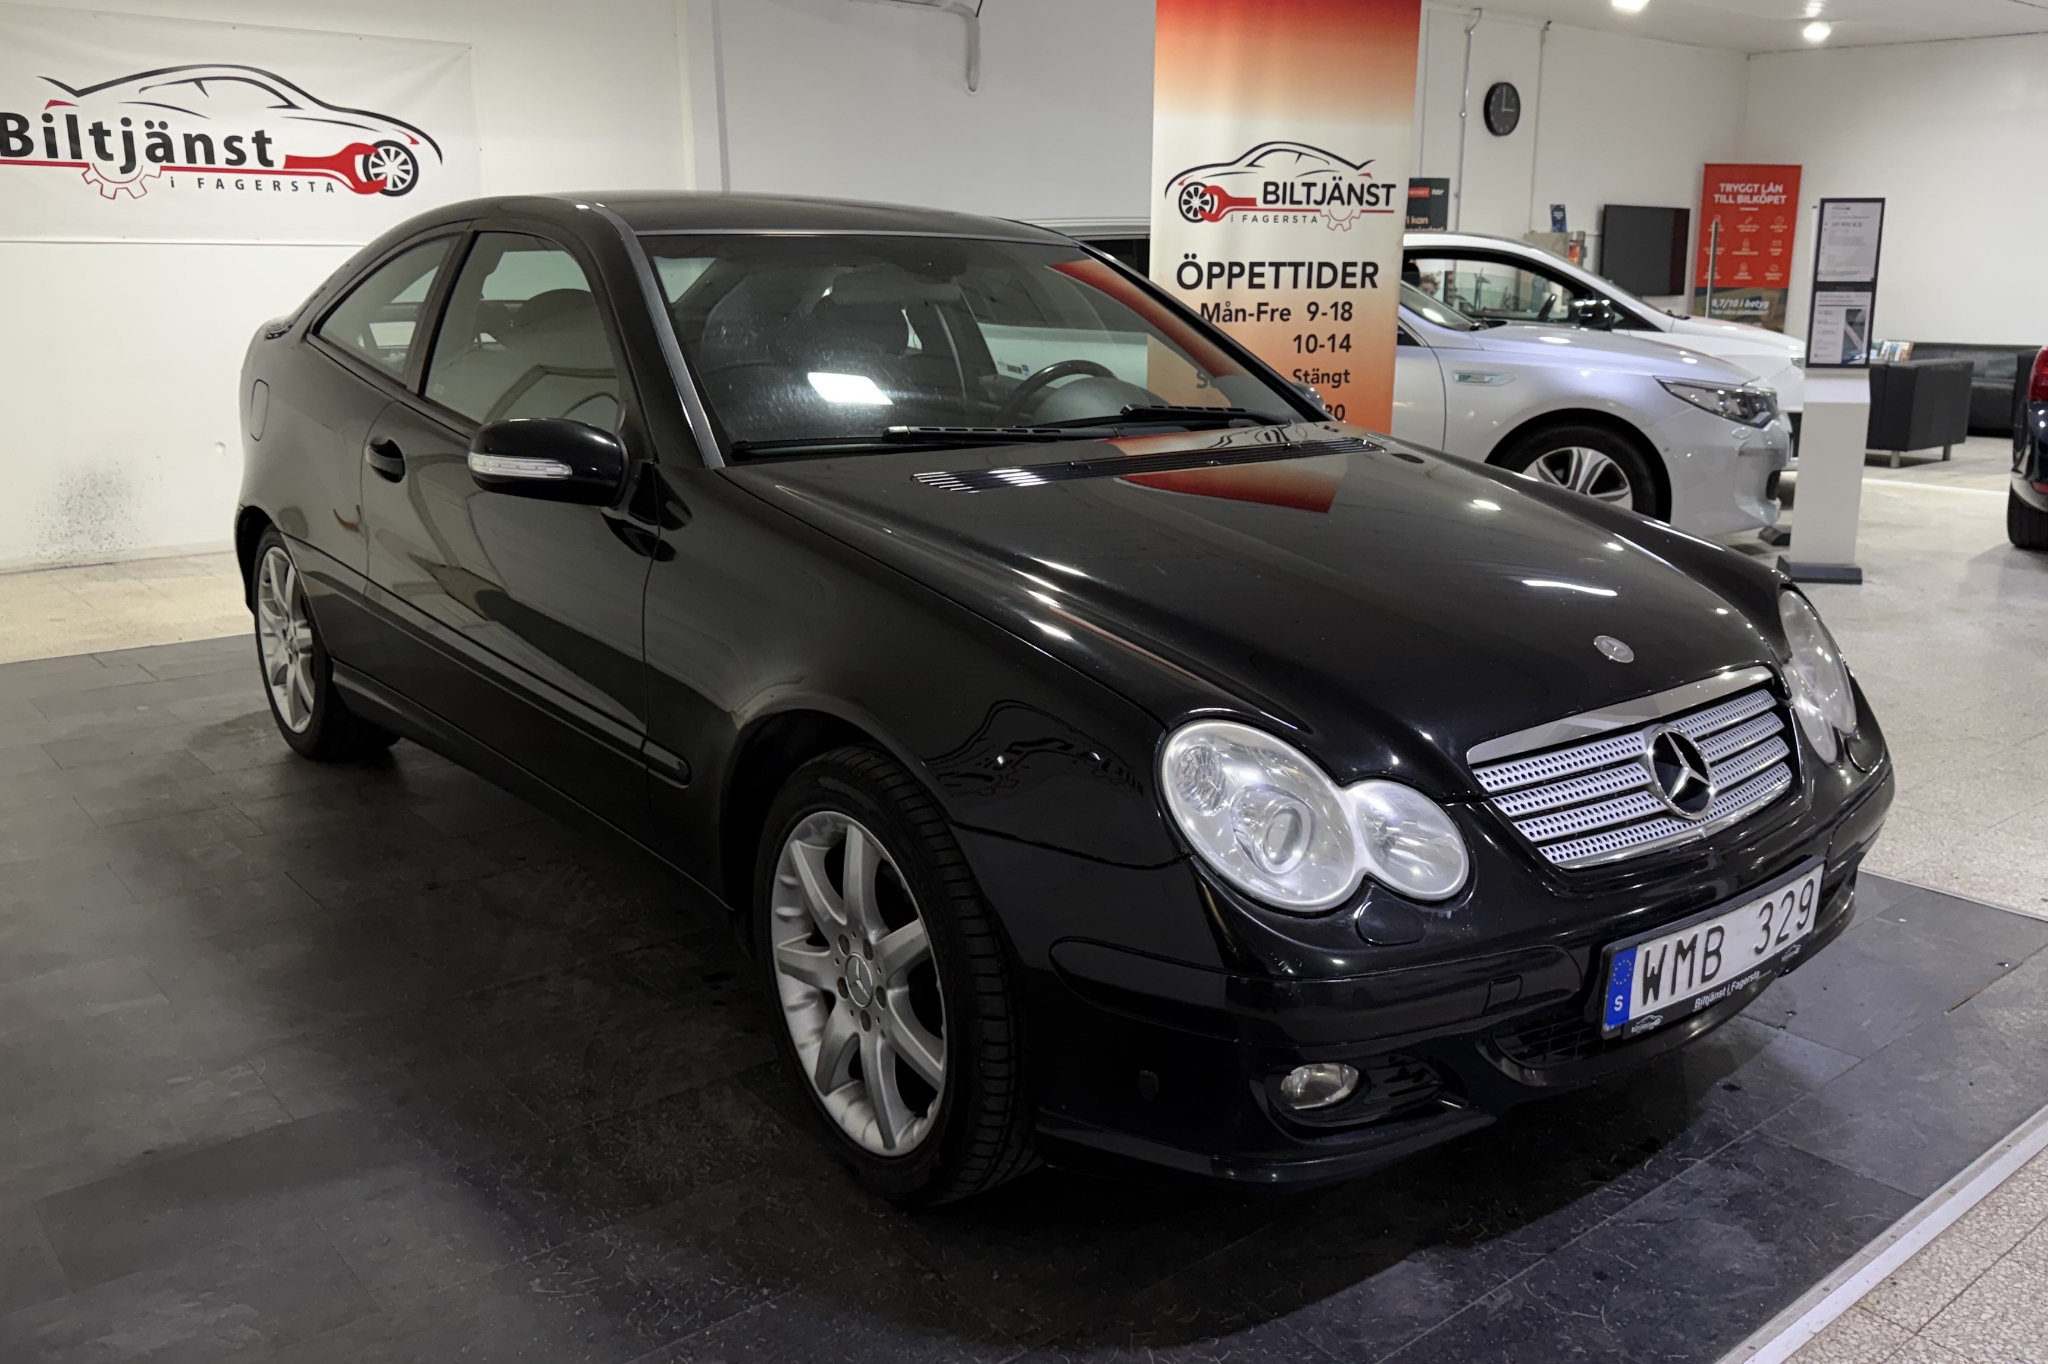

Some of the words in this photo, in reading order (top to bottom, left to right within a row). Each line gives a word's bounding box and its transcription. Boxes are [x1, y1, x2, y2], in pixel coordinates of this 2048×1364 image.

[0, 112, 274, 174] Biltjänst
[170, 177, 175, 188] i
[197, 177, 336, 193] FAGERSTA
[1262, 176, 1397, 207] BILTJÄNST
[1719, 183, 1759, 193] TRYGGT
[1761, 182, 1783, 193] LÅN
[1713, 194, 1735, 204] TILL
[1737, 192, 1787, 205] BILKÖPET
[1230, 214, 1234, 223] i
[1242, 214, 1318, 224] FAGERSTA
[1176, 253, 1379, 291] ÖPPETTIDER
[1200, 301, 1292, 323] Mån-Fre
[1306, 301, 1354, 322] 9-18
[1293, 333, 1352, 354] 10-14
[1292, 368, 1351, 389] Stängt
[1642, 924, 1725, 1006] WMB
[1754, 878, 1815, 955] 329
[1694, 986, 1726, 1009] Biltjänst
[1731, 970, 1760, 992] Fagersta
[1613, 994, 1625, 1012] S
